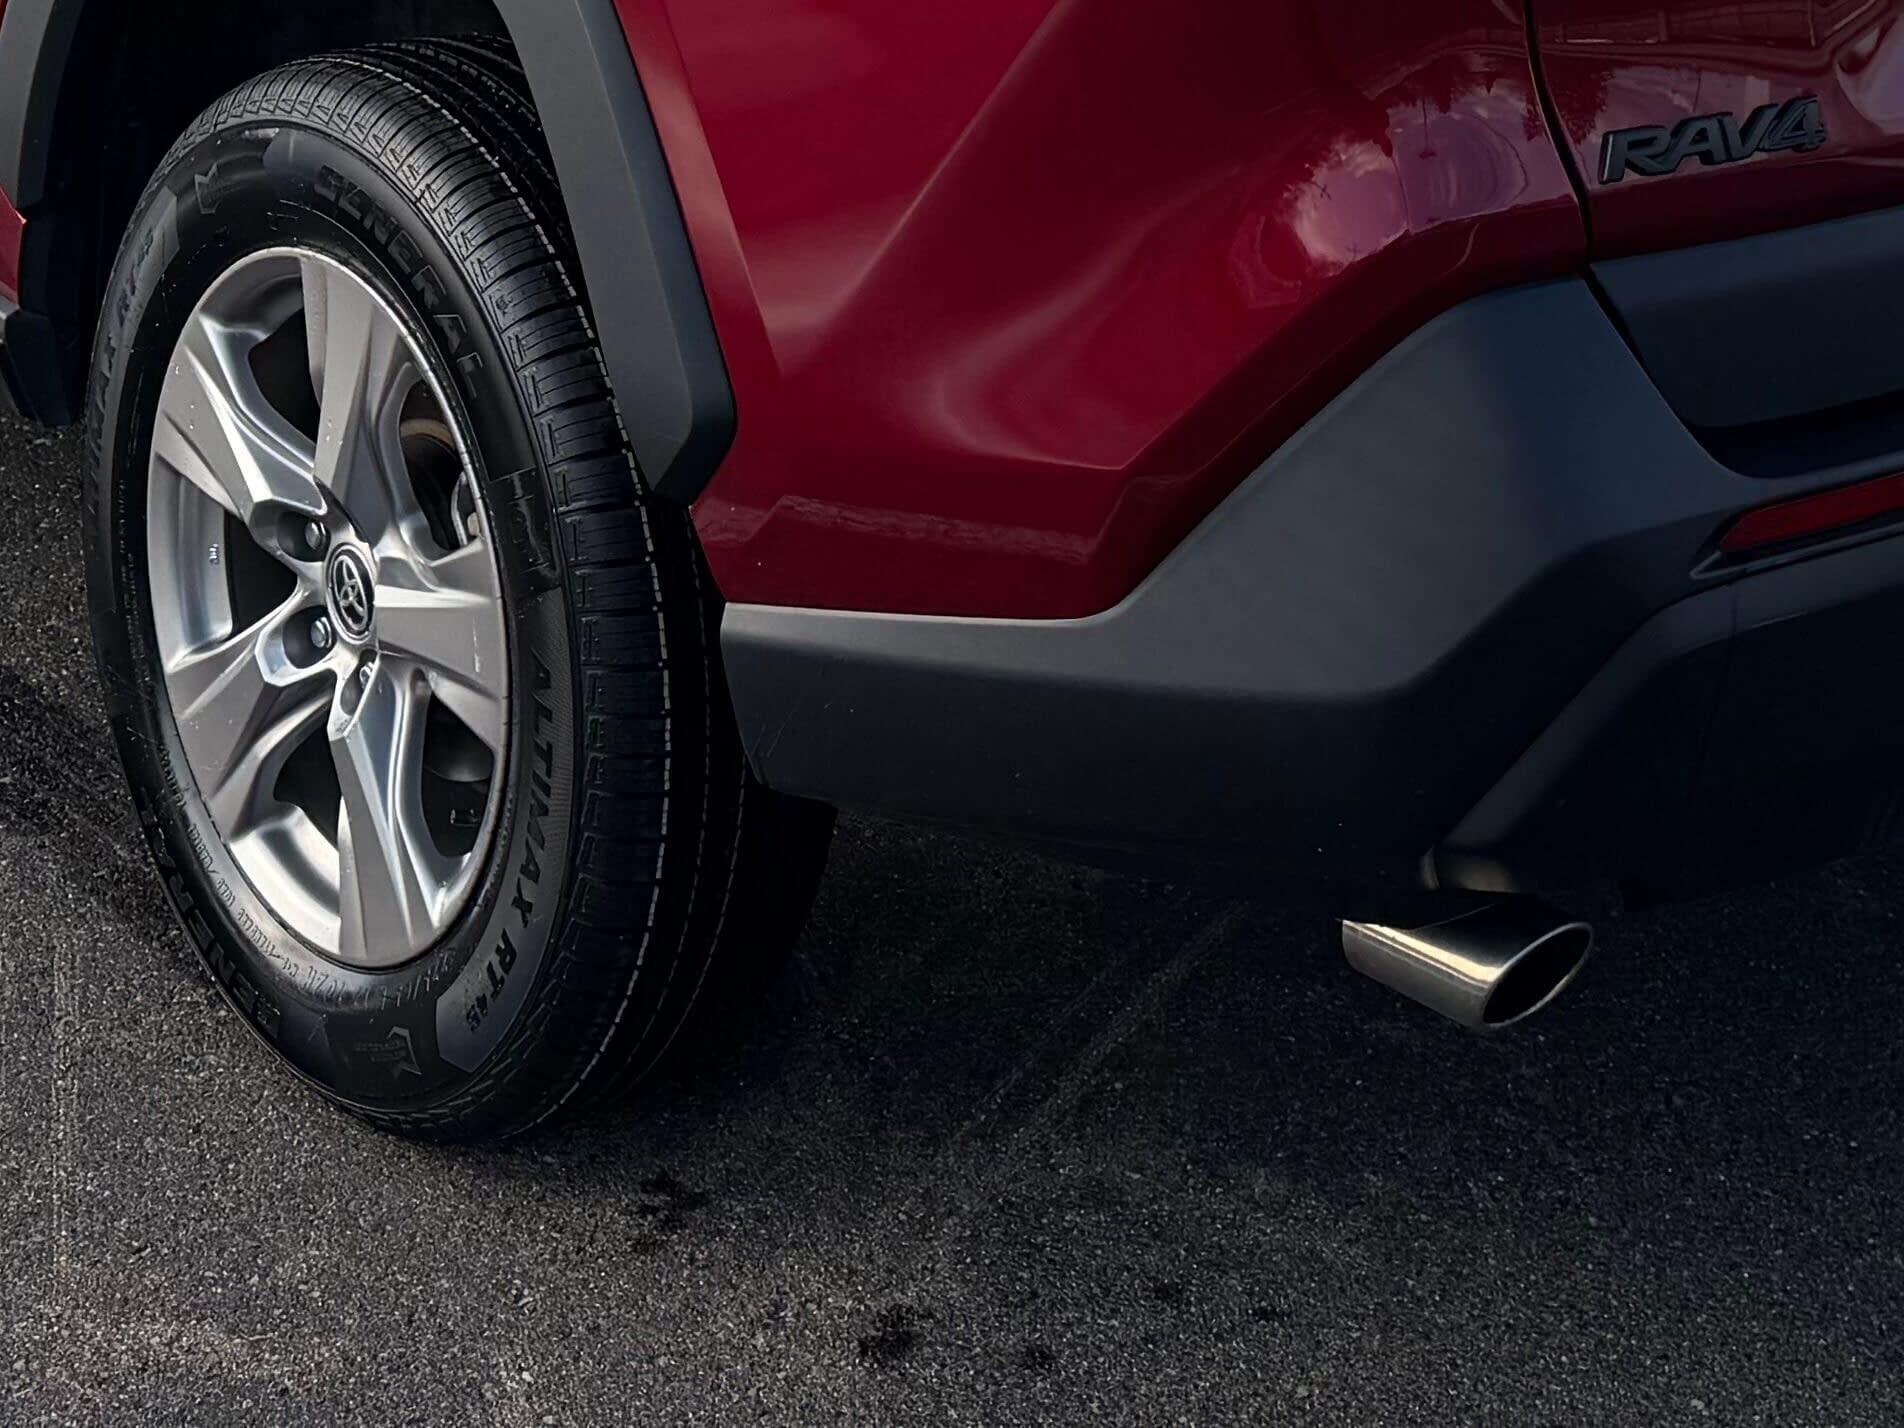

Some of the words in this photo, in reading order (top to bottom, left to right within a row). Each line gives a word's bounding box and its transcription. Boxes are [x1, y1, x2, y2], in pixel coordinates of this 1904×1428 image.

[1599, 95, 1827, 185] RAV4
[314, 164, 485, 400] GENERAL
[510, 647, 554, 929] ALTIMAX
